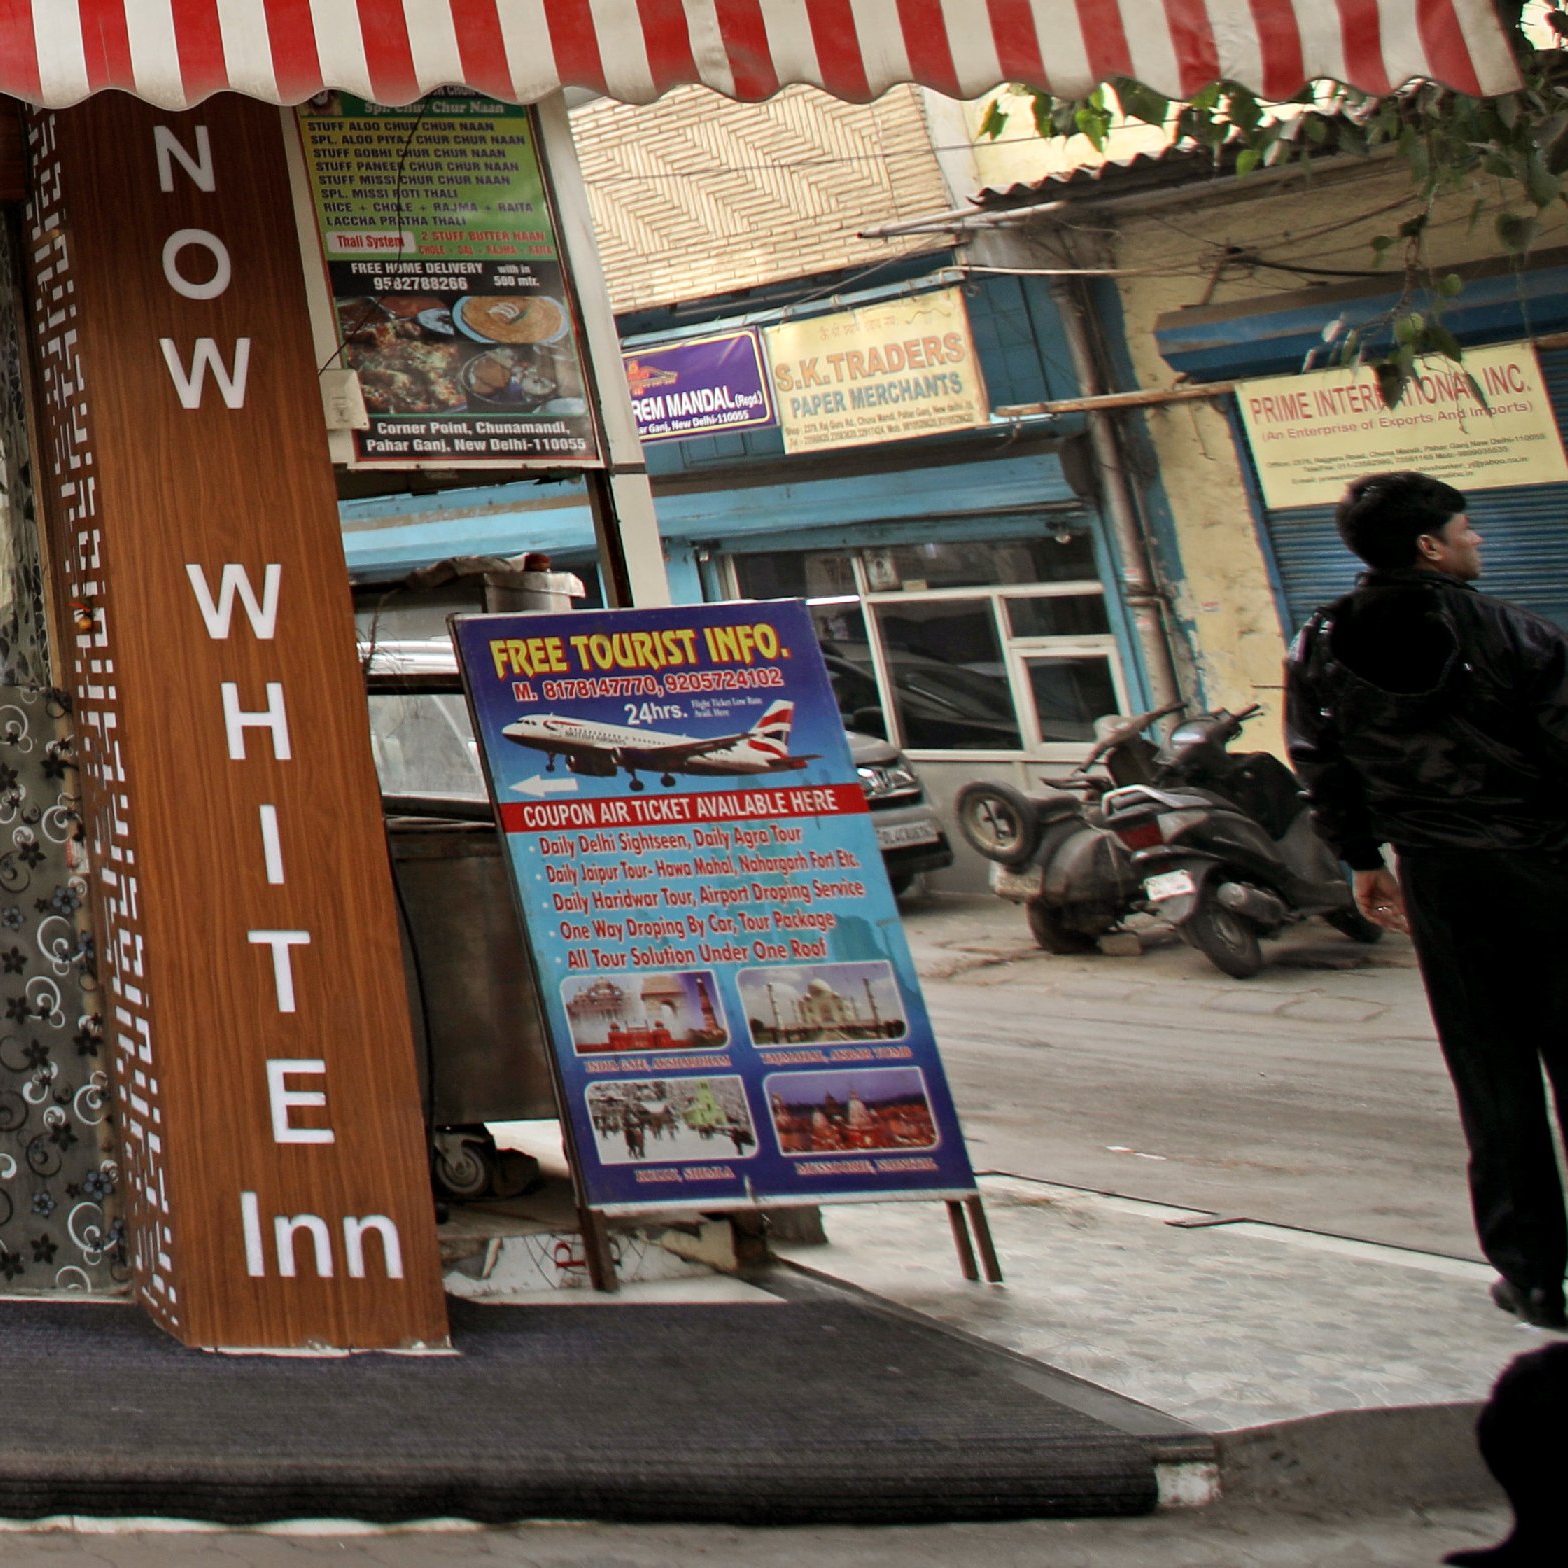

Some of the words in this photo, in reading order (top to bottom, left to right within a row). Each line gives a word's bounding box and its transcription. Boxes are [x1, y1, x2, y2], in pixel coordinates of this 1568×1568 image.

[336, 235, 364, 248] Thali
[351, 262, 383, 274] FREE
[385, 262, 424, 274] HOME
[425, 262, 483, 274] DELIVERY
[665, 385, 735, 418] MANDAL
[790, 390, 846, 418] PAPER
[848, 371, 963, 410] MERCHANTS
[1249, 392, 1313, 425] PRIME
[1482, 363, 1532, 397] INC.
[376, 422, 426, 435] Corner
[672, 419, 691, 430] New
[1288, 423, 1358, 441] Enterprise
[1361, 420, 1373, 431] of
[1379, 414, 1434, 431] Exports
[366, 439, 409, 452] Pahar
[454, 438, 486, 452] New
[490, 437, 586, 451] Delhi-110055
[489, 636, 569, 681] FREE
[570, 629, 697, 672] TOURIST
[703, 622, 791, 666] INFO.
[513, 682, 539, 702] M.
[625, 702, 688, 725] 24hrs.
[523, 803, 596, 827] COUPON
[600, 800, 629, 823] AIR
[632, 797, 691, 821] TICKET
[696, 791, 788, 819] AVAILABLE
[791, 789, 839, 812] HERE
[539, 836, 575, 858] Daily
[578, 833, 615, 853] Delhi
[618, 829, 692, 856] Sightseen,
[693, 826, 731, 851] Daily
[733, 826, 769, 848] Agra
[770, 824, 802, 843] Tour
[546, 863, 578, 886] Daily
[581, 860, 619, 885] Jaipur
[656, 857, 692, 878] Hawa
[738, 851, 808, 877] Nahargarh
[811, 850, 834, 868] Fort
[837, 848, 861, 867] Etc.
[553, 892, 590, 915] Daily
[593, 888, 658, 910] Haridwar
[700, 883, 750, 906] Airport
[752, 880, 811, 905] Droping
[813, 878, 866, 898] Service
[560, 921, 590, 940] One
[593, 918, 624, 943] Way
[627, 916, 684, 942] Droping
[686, 913, 705, 937] By
[738, 910, 770, 931] Tour
[773, 908, 836, 934] Package
[567, 949, 588, 969] All
[590, 948, 627, 968] Tour
[630, 944, 697, 966] Solution
[699, 943, 748, 963] Under
[752, 940, 788, 960] One
[790, 936, 828, 958] Roof
[240, 1191, 403, 1279] Inn
